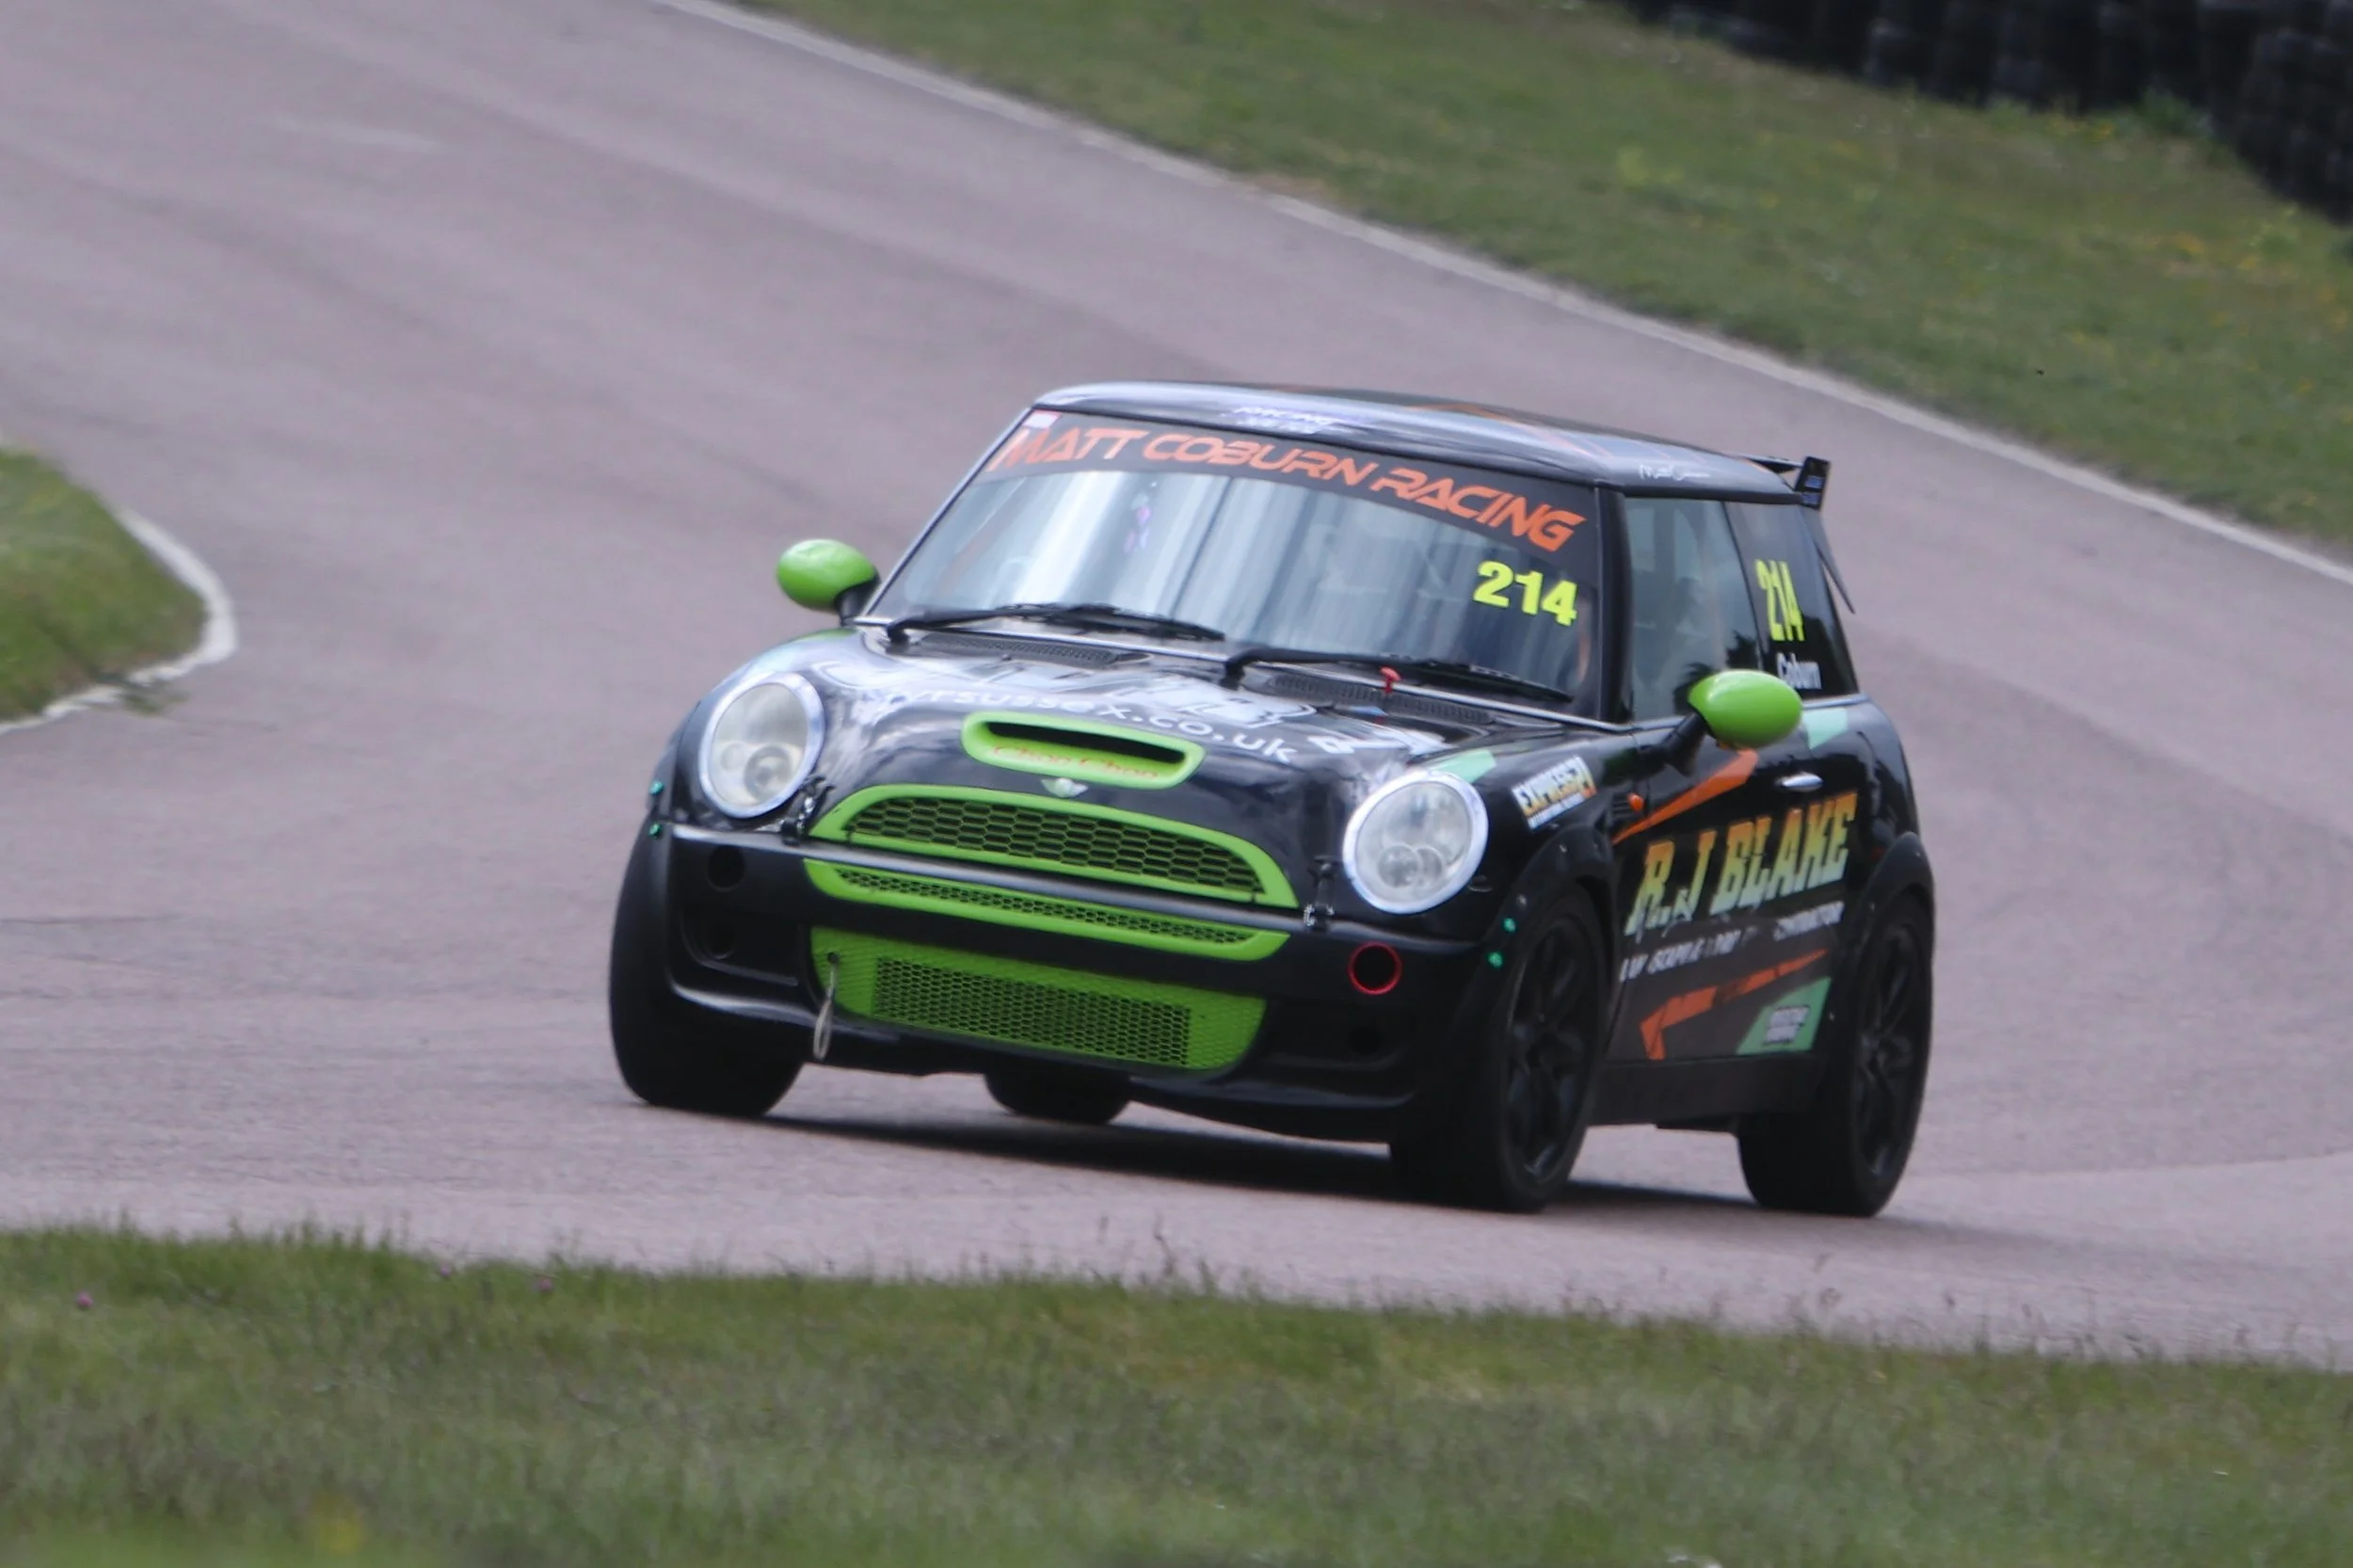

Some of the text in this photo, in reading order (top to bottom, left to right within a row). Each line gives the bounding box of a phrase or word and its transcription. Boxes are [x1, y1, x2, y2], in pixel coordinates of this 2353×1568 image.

[988, 427, 1587, 552] MATT COBURN RACING
[1473, 560, 1578, 626] 214
[1754, 559, 1805, 641] 214
[1709, 792, 1858, 916] BLAKE
